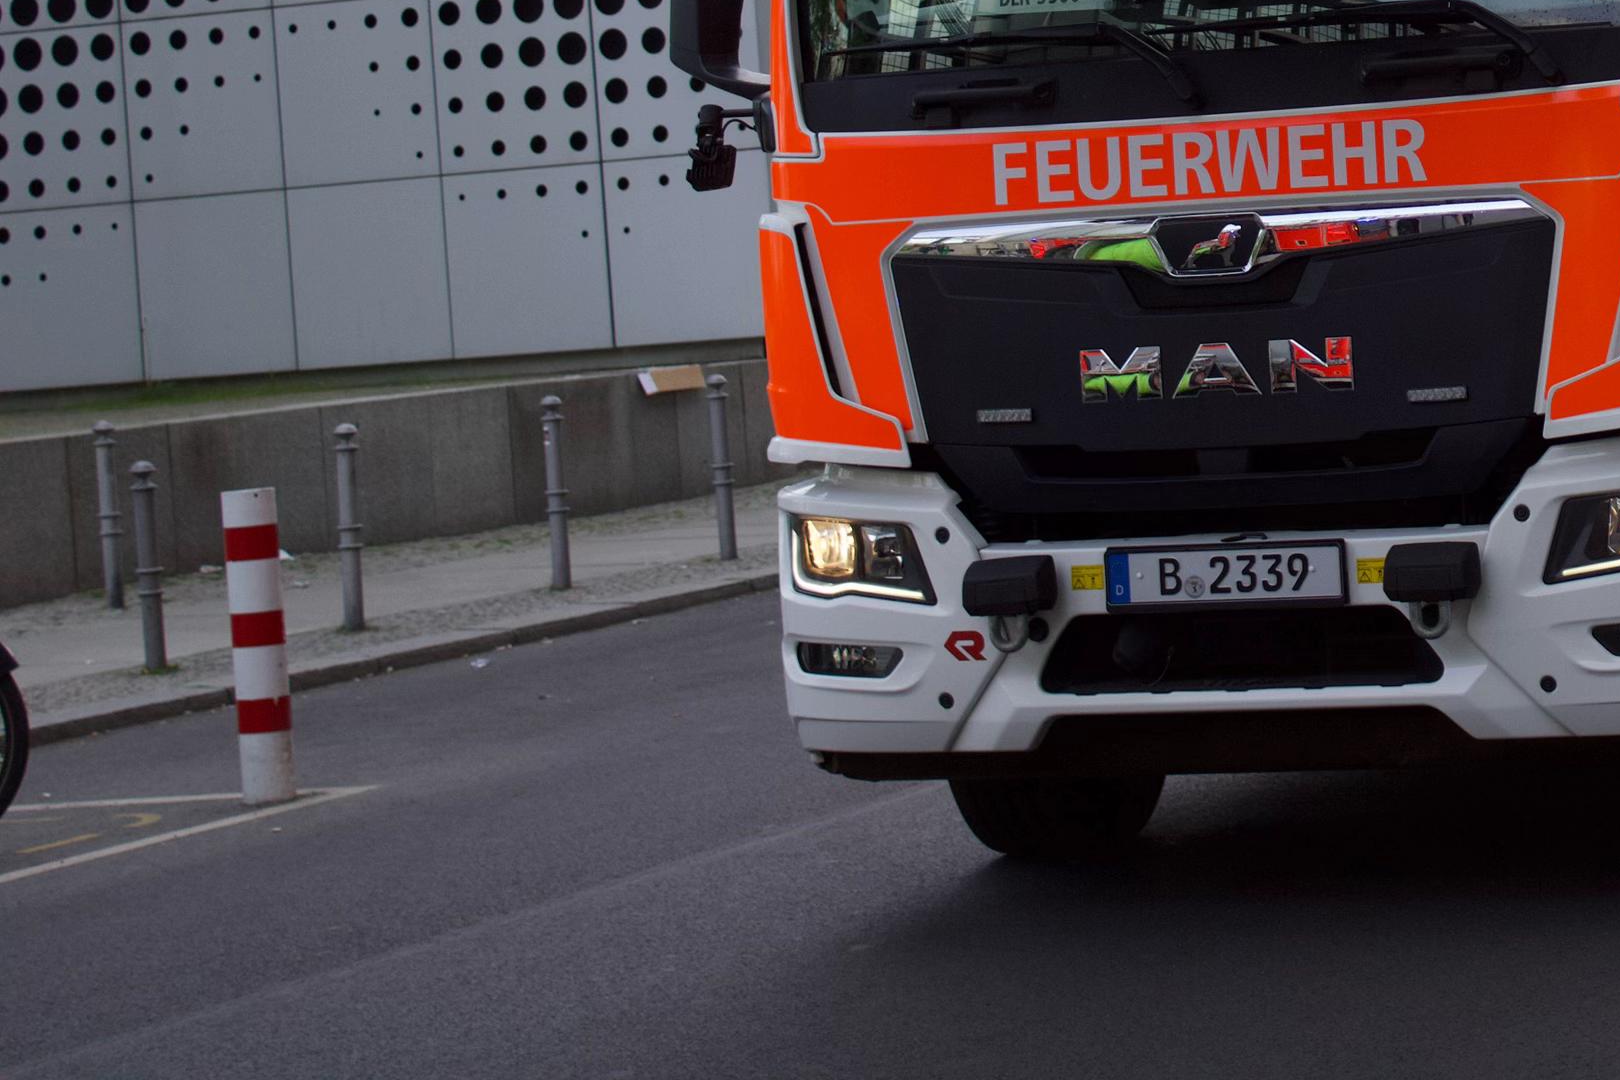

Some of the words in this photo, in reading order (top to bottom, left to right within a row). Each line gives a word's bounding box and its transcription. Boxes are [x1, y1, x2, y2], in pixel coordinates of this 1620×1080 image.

[993, 118, 1428, 206] FEUERWEHR
[1079, 335, 1356, 404] MAN
[1159, 557, 1183, 597] B
[1208, 552, 1310, 597] 2339
